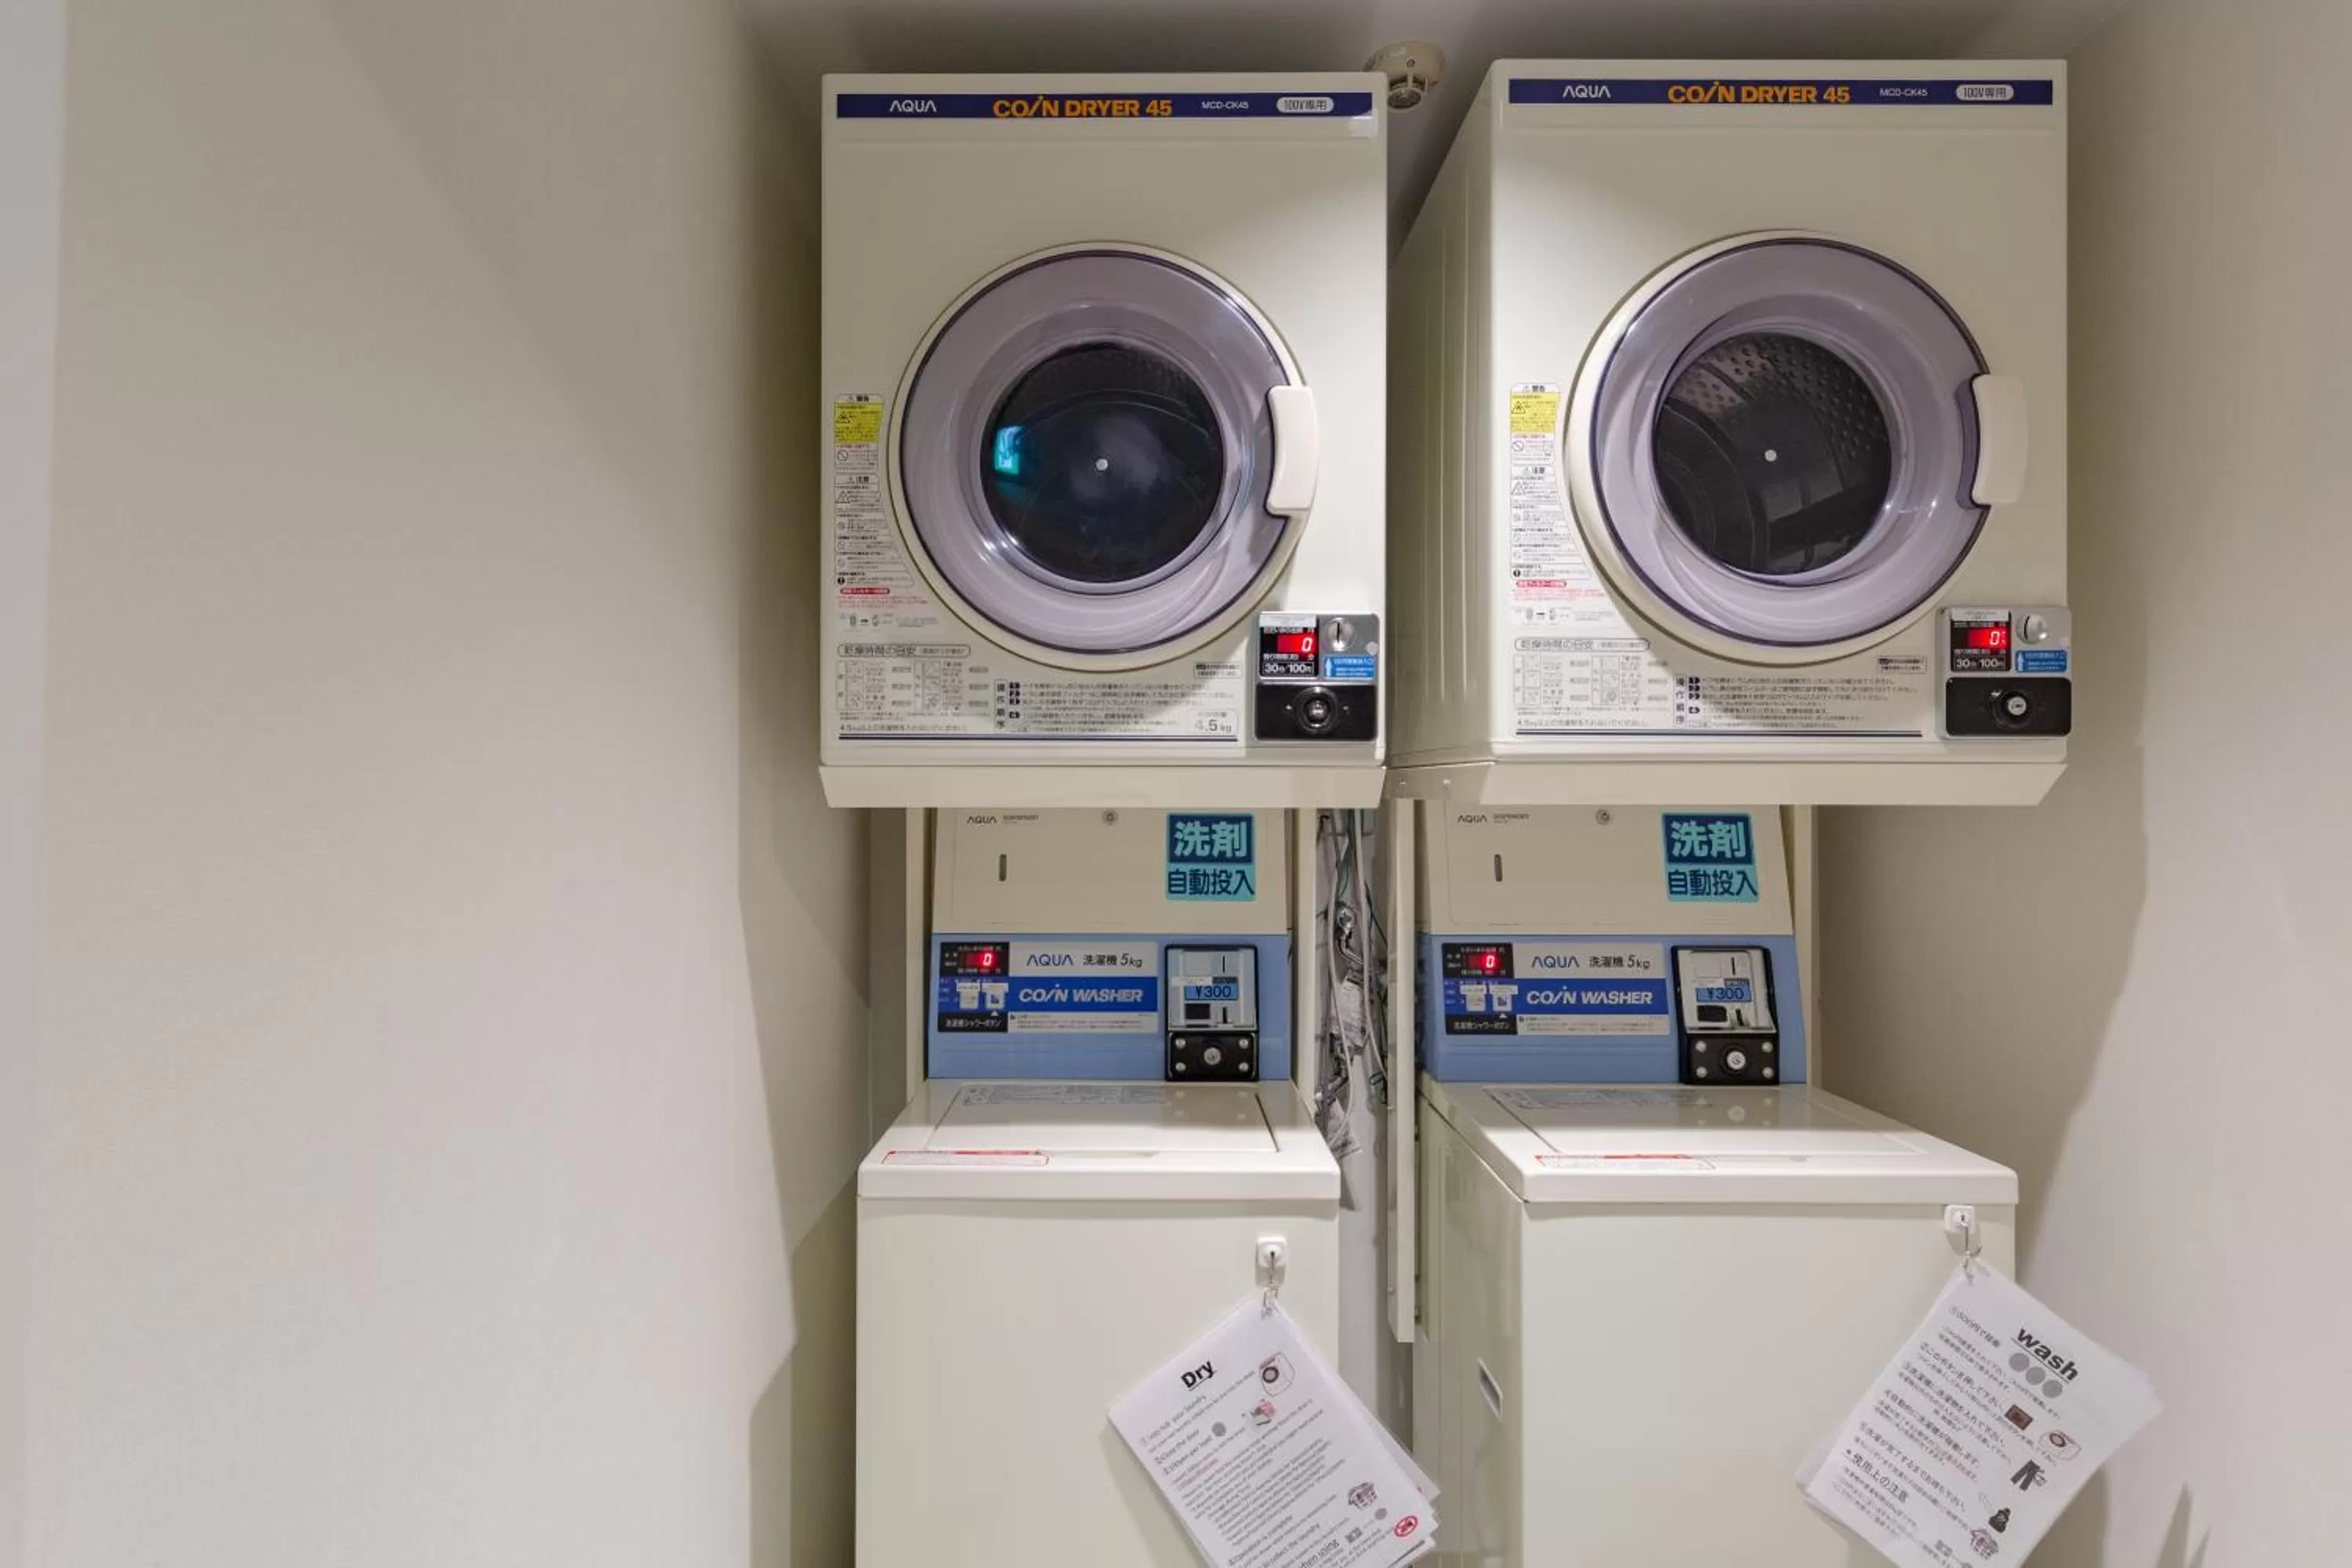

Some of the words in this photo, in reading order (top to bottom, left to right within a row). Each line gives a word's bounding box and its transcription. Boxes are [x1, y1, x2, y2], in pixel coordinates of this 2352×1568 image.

[1563, 85, 1611, 98] AQUA
[1740, 85, 1817, 103] DRYER
[1823, 85, 1851, 103] 45
[1879, 88, 1928, 96] MCD-CK45
[889, 100, 938, 113] AQUA
[1065, 100, 1140, 117] DRYER
[1145, 100, 1173, 117] 45
[1301, 637, 1313, 652] 0
[1989, 630, 2001, 645] 0
[967, 815, 997, 823] AQUA
[1457, 815, 1487, 823] AQUA
[1174, 821, 1247, 858] 洗剤
[1671, 820, 1746, 858] 洗剤
[1167, 869, 1254, 896] 自動投入
[1668, 869, 1759, 896] 自動投入
[982, 953, 993, 966] 0
[1026, 954, 1073, 966] AQUA
[1083, 954, 1117, 966] 洗濯機
[1486, 955, 1496, 968] 0
[1531, 956, 1580, 968] AQUA
[1589, 956, 1624, 968] 洗濯機
[1072, 989, 1143, 1003] WASHER
[1581, 990, 1653, 1004] WASHER
[2016, 1328, 2078, 1381] wash
[1181, 1360, 1217, 1388] Dry
